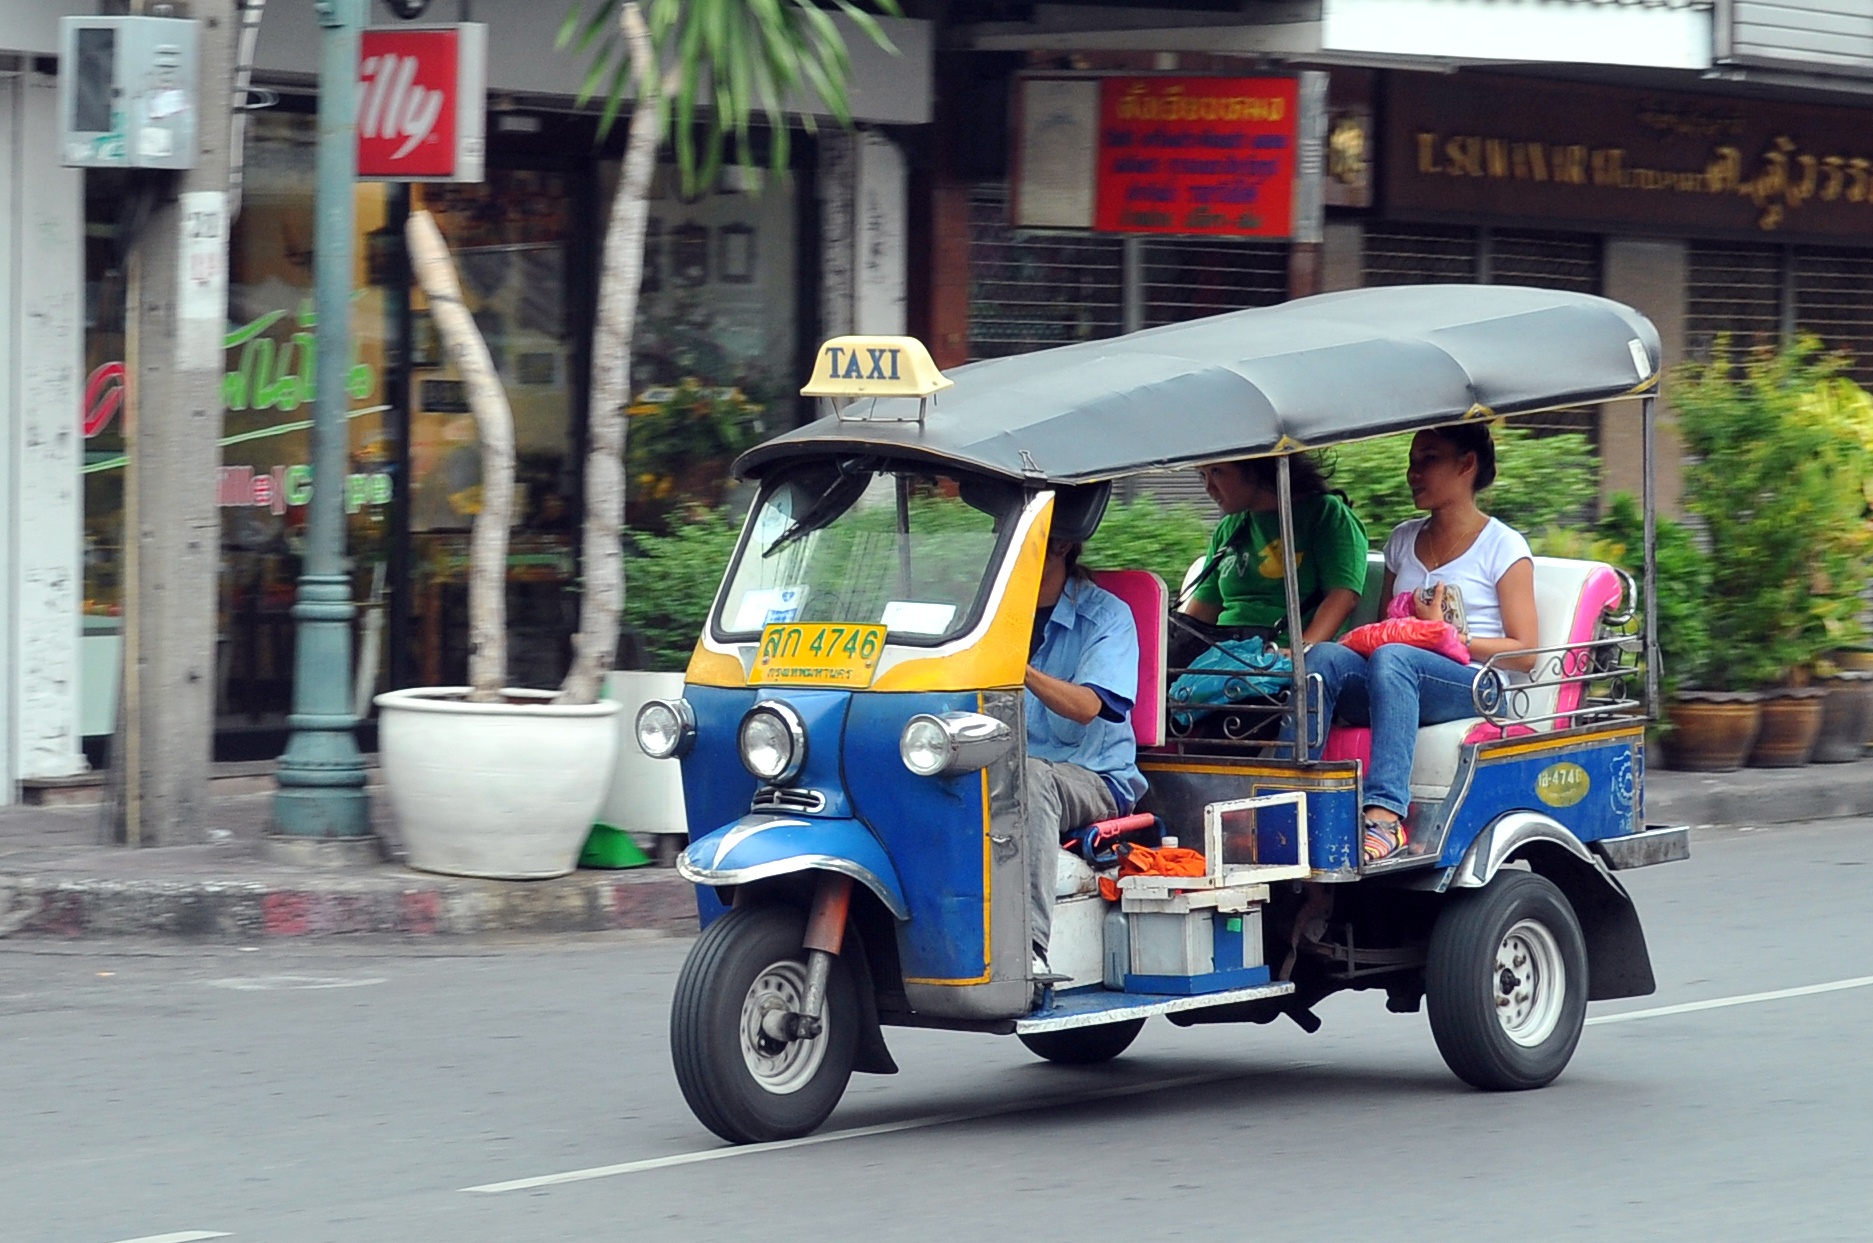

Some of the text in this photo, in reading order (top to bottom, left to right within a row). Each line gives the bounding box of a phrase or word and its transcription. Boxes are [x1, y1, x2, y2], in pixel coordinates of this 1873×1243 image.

[354, 54, 445, 160] illy
[825, 347, 901, 380] TAXI
[809, 628, 879, 660] 4746
